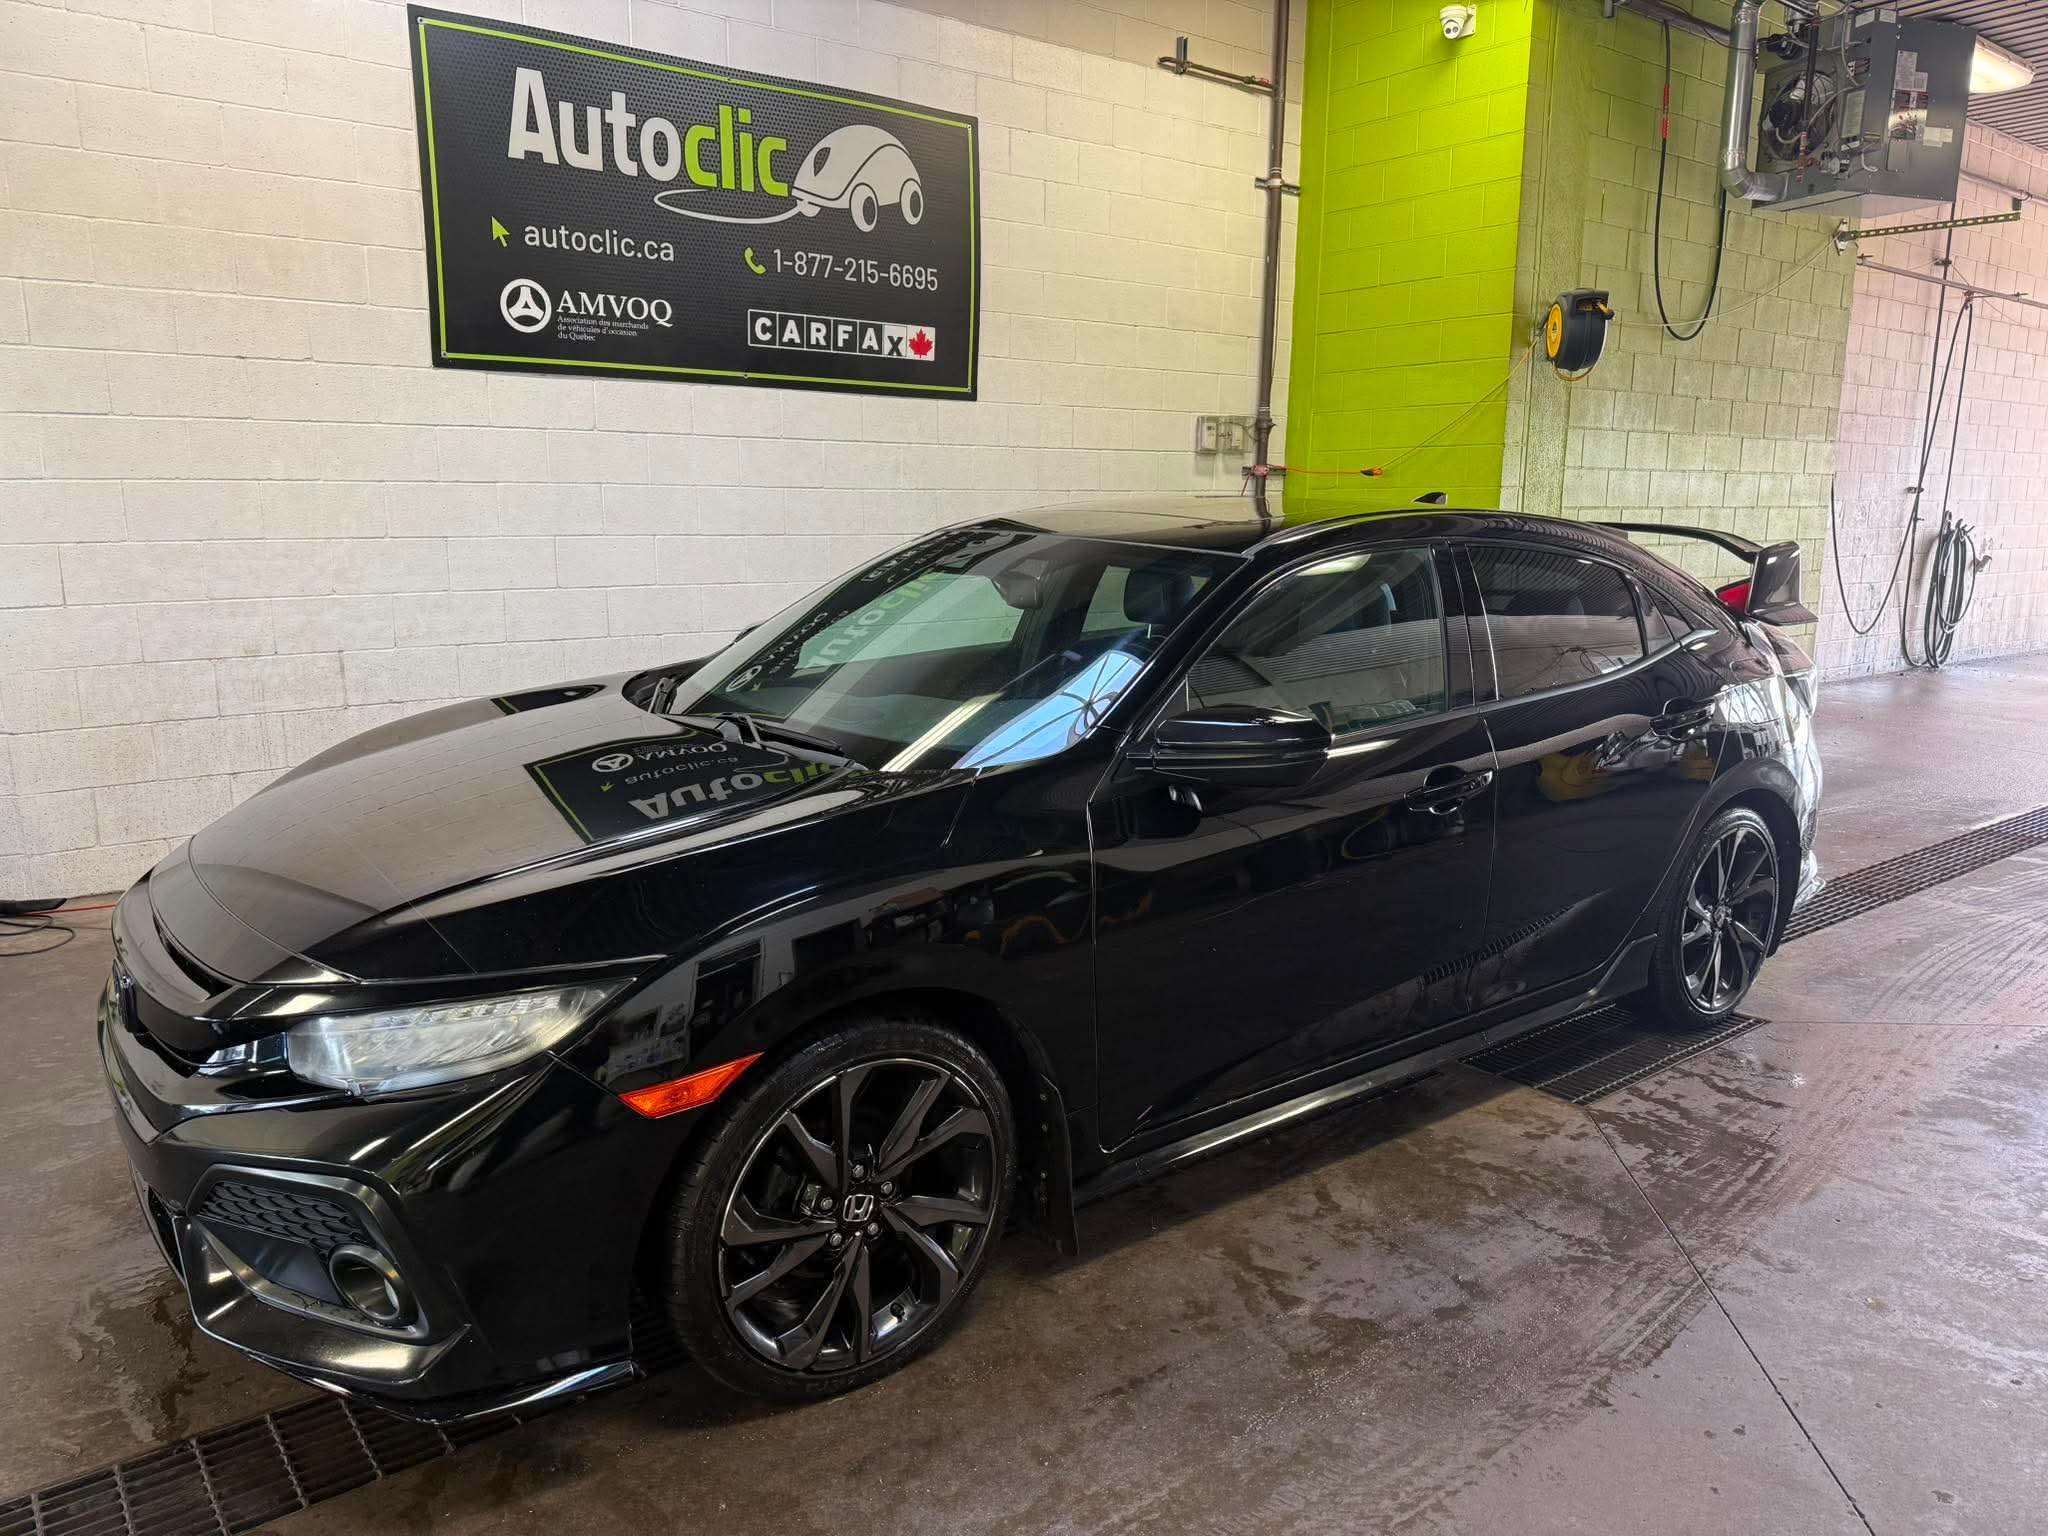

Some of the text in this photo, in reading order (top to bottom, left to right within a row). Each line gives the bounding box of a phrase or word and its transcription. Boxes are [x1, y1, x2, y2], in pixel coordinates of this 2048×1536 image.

[508, 67, 789, 197] Autoclic
[524, 224, 675, 262] autoclic.ca
[773, 248, 938, 291] 1-877-215-6695
[557, 290, 673, 327] AMVOQ
[557, 323, 567, 331] de
[557, 331, 568, 339] du
[755, 317, 905, 357] CARFAX
